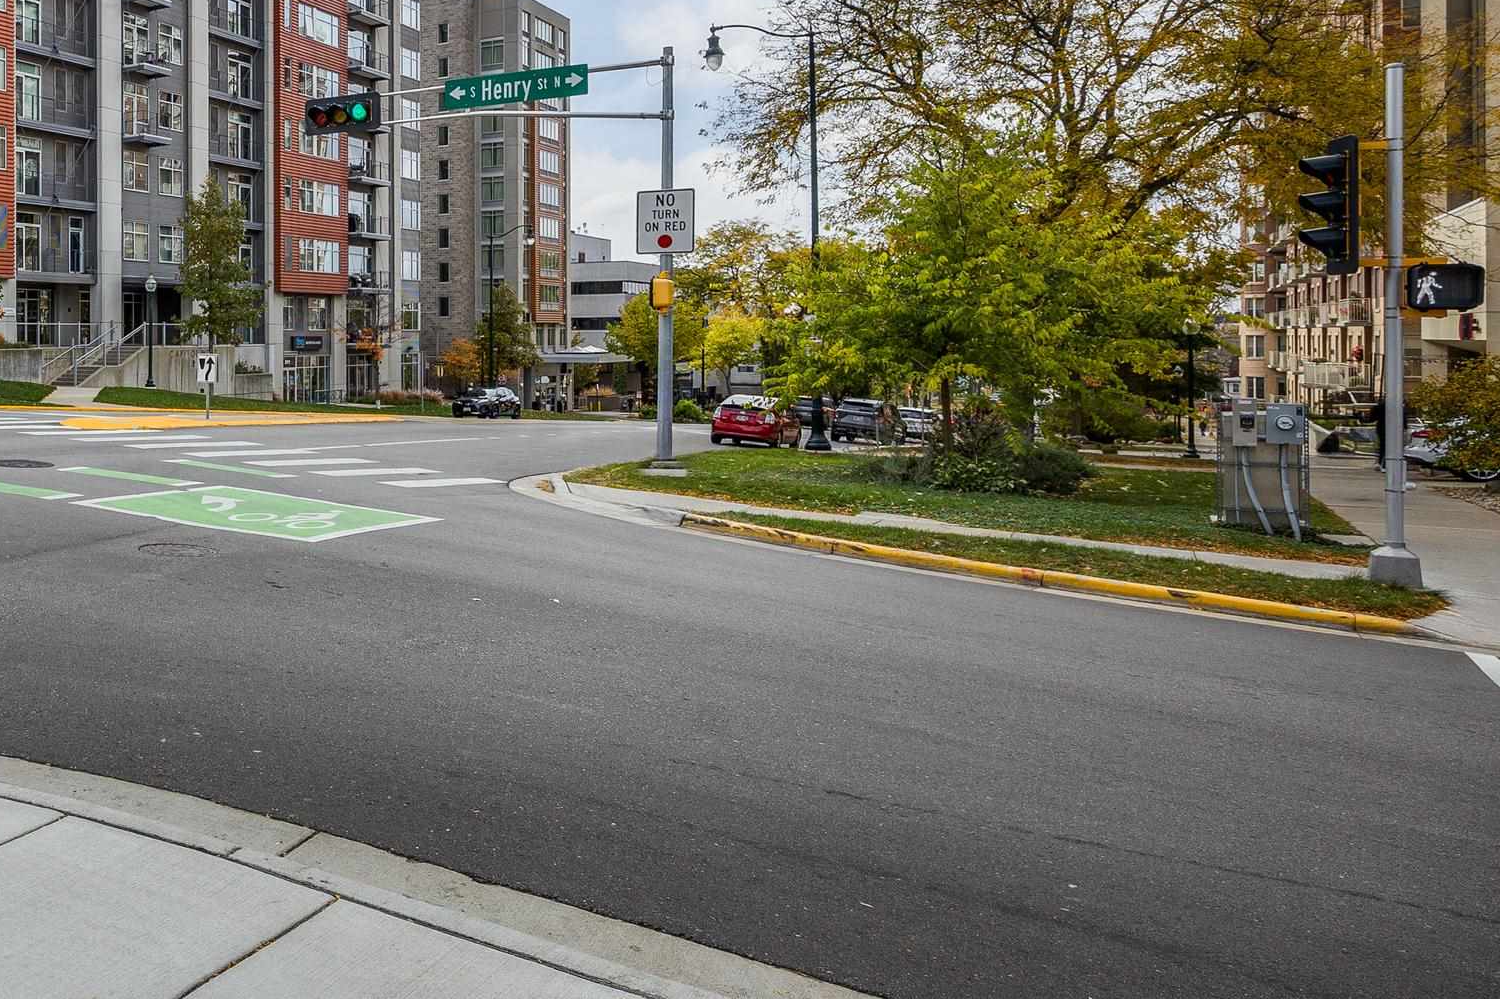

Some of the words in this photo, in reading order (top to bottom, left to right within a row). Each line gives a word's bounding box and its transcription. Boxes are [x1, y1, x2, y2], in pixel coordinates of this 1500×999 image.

[470, 86, 476, 98] S
[481, 79, 532, 101] Henry
[537, 77, 548, 90] St
[554, 75, 561, 88] N
[656, 193, 675, 207] NO
[652, 209, 679, 219] TURN
[645, 222, 659, 232] ON
[664, 221, 686, 231] RED
